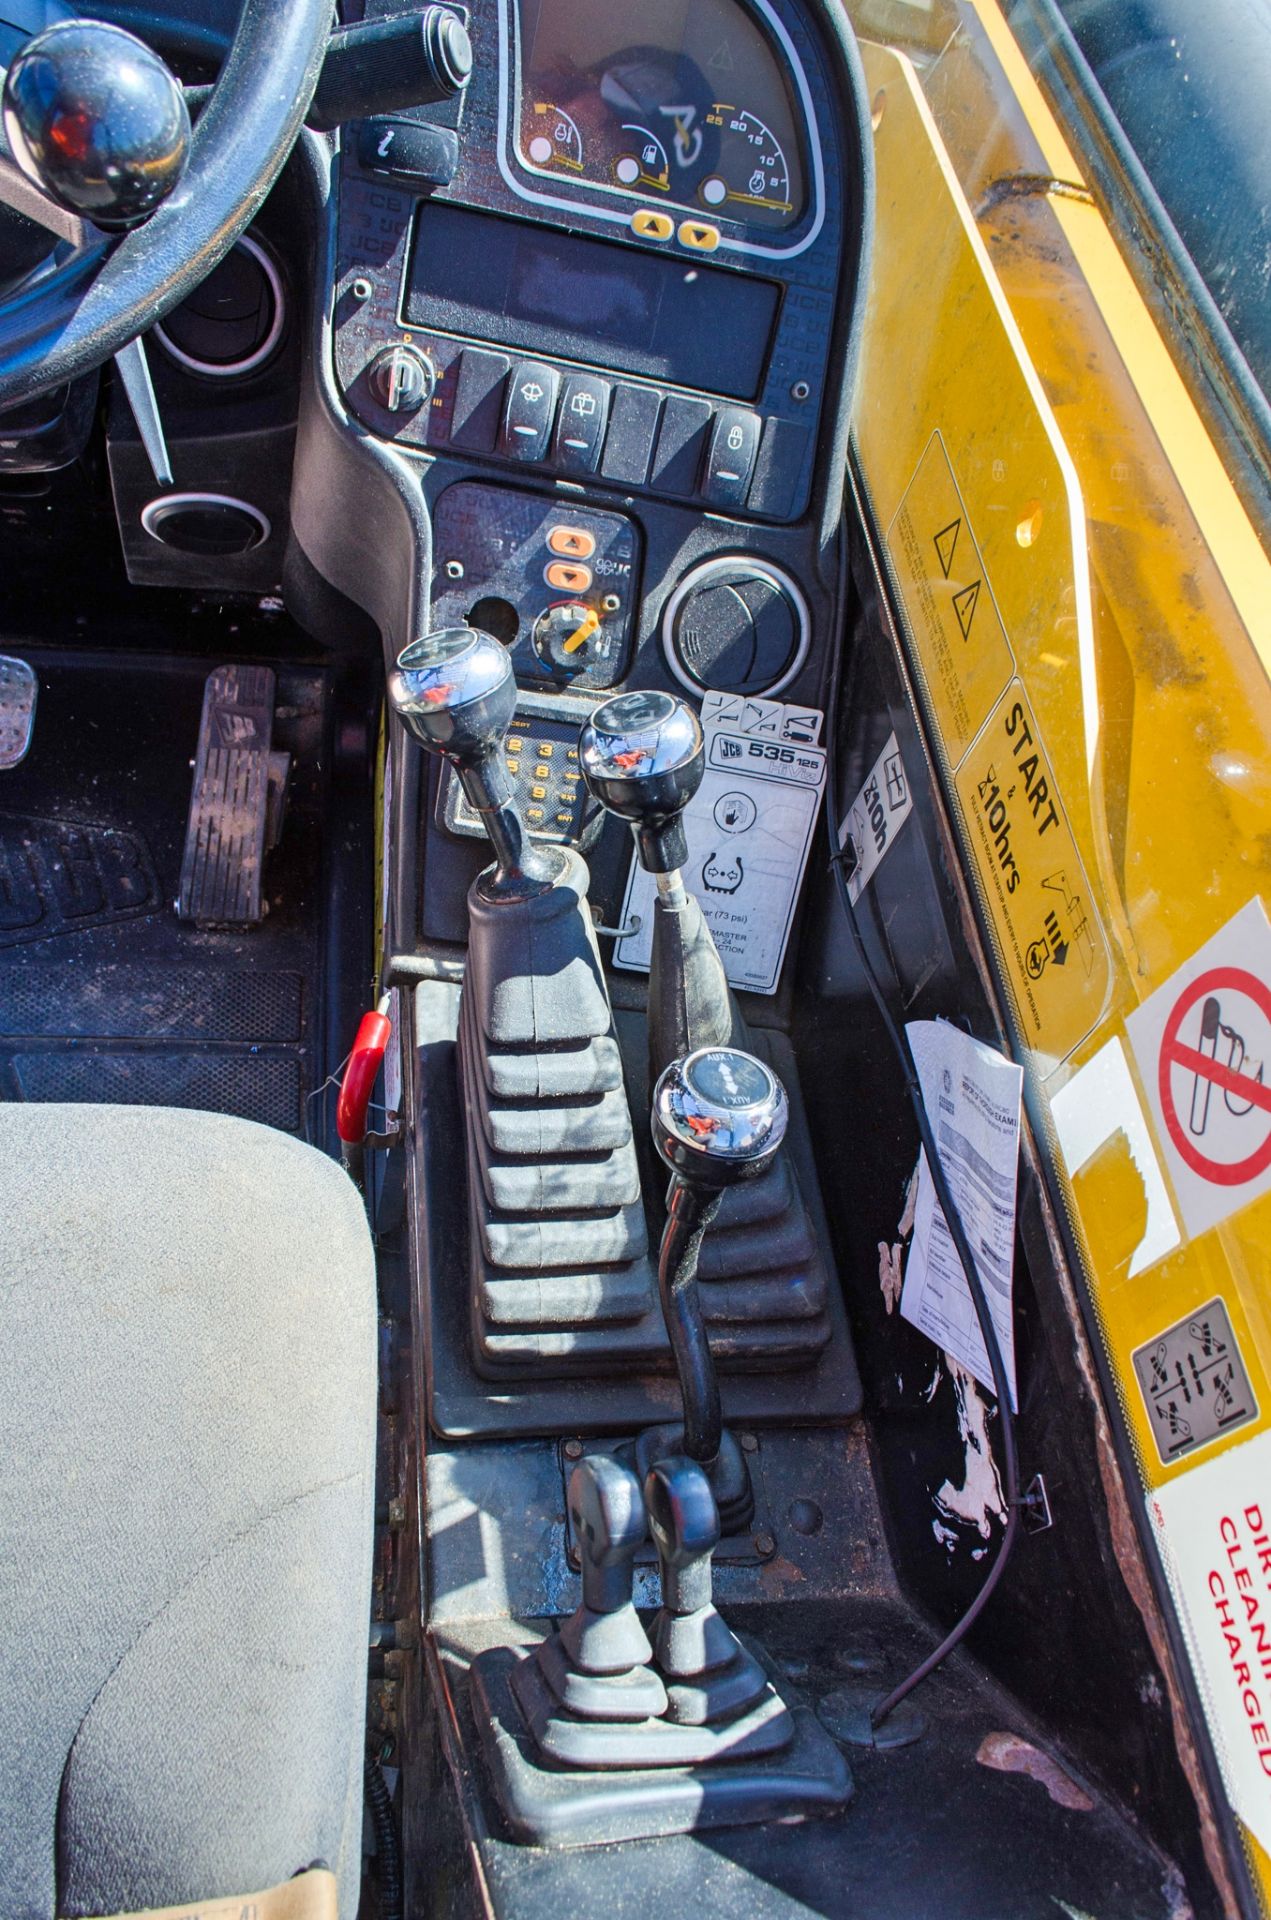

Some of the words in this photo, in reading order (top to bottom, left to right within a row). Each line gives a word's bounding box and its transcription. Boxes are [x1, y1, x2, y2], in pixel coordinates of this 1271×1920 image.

[706, 114, 723, 126] 25
[730, 120, 747, 132] 20
[748, 134, 763, 145] 15
[760, 155, 775, 166] 10
[770, 177, 779, 187] 5
[508, 738, 522, 751] 2
[540, 744, 553, 756] 3
[721, 740, 742, 758] JCB
[748, 742, 796, 763] 535
[796, 758, 819, 769] 125
[768, 761, 817, 781] HiViz
[1005, 703, 1060, 836] START
[868, 792, 887, 854] 10h
[984, 785, 1020, 894] 10hrs
[715, 911, 730, 919] (73
[731, 914, 748, 924] psi)
[709, 929, 747, 941] MASTER
[1025, 986, 1041, 1032] OPERATION
[1243, 1503, 1271, 1591] DIR
[1208, 1570, 1271, 1777] CHARGED
